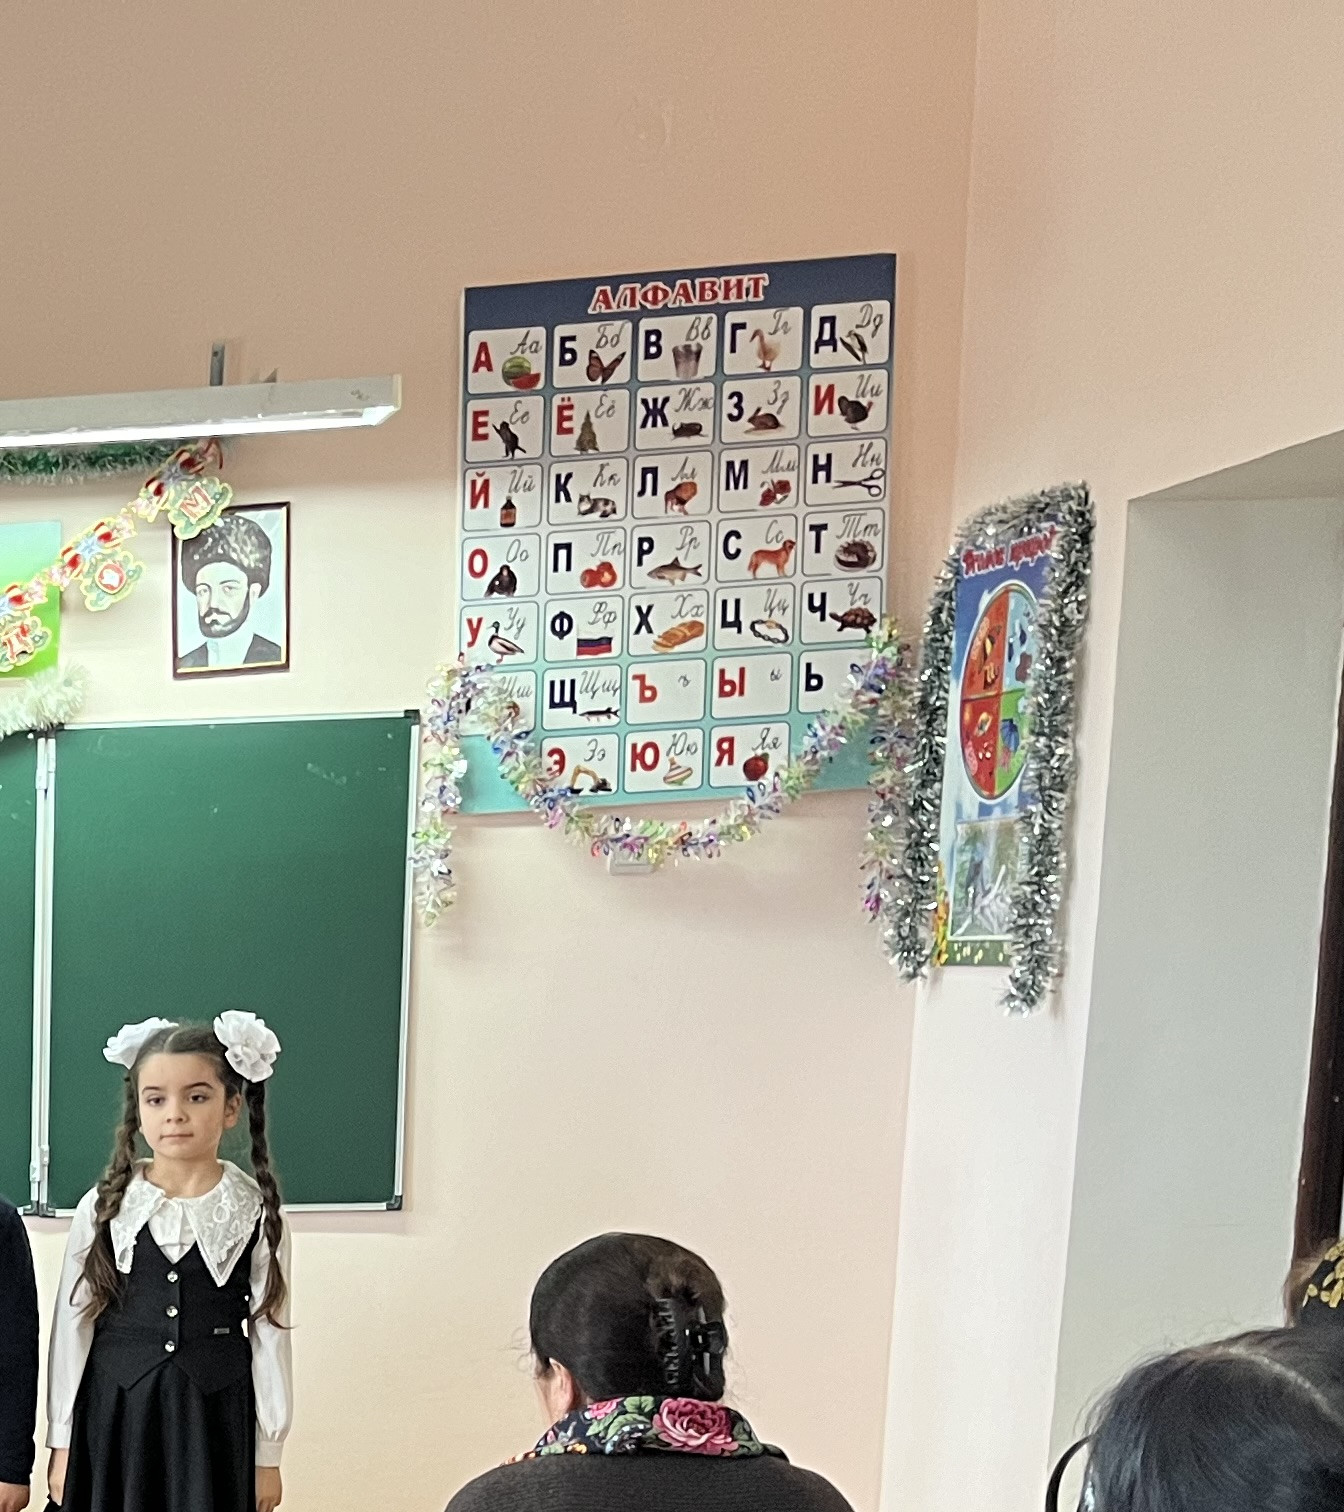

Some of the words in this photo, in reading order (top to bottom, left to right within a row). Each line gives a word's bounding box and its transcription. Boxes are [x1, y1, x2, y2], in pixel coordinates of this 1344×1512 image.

[592, 275, 767, 312] АЛФАВИТ
[472, 342, 493, 373] А
[559, 336, 578, 367] Б
[644, 330, 662, 360] В
[730, 322, 746, 353] Г
[815, 316, 837, 354] Д
[472, 410, 489, 441] Е
[557, 397, 574, 435] Ё
[640, 396, 669, 428] Ж
[727, 391, 744, 422] З
[814, 384, 834, 415] И
[470, 472, 490, 509] Й
[555, 472, 573, 503] К
[637, 466, 658, 497] Л
[725, 459, 748, 491] М
[812, 453, 832, 484] Н
[468, 549, 488, 578] О
[553, 543, 572, 572] П
[637, 536, 654, 567] Р
[723, 530, 742, 560] С
[810, 523, 828, 553] Т
[467, 617, 483, 648] У
[550, 611, 573, 640] Ф
[634, 604, 654, 635] Х
[721, 598, 742, 634] Ц
[808, 592, 826, 622] Ч
[549, 679, 577, 714] Щ
[632, 674, 657, 703] Ъ
[718, 667, 746, 698] Ы
[805, 663, 823, 691] Ь
[546, 748, 565, 777] Э
[630, 742, 660, 772] Ю
[715, 737, 734, 767] Я
